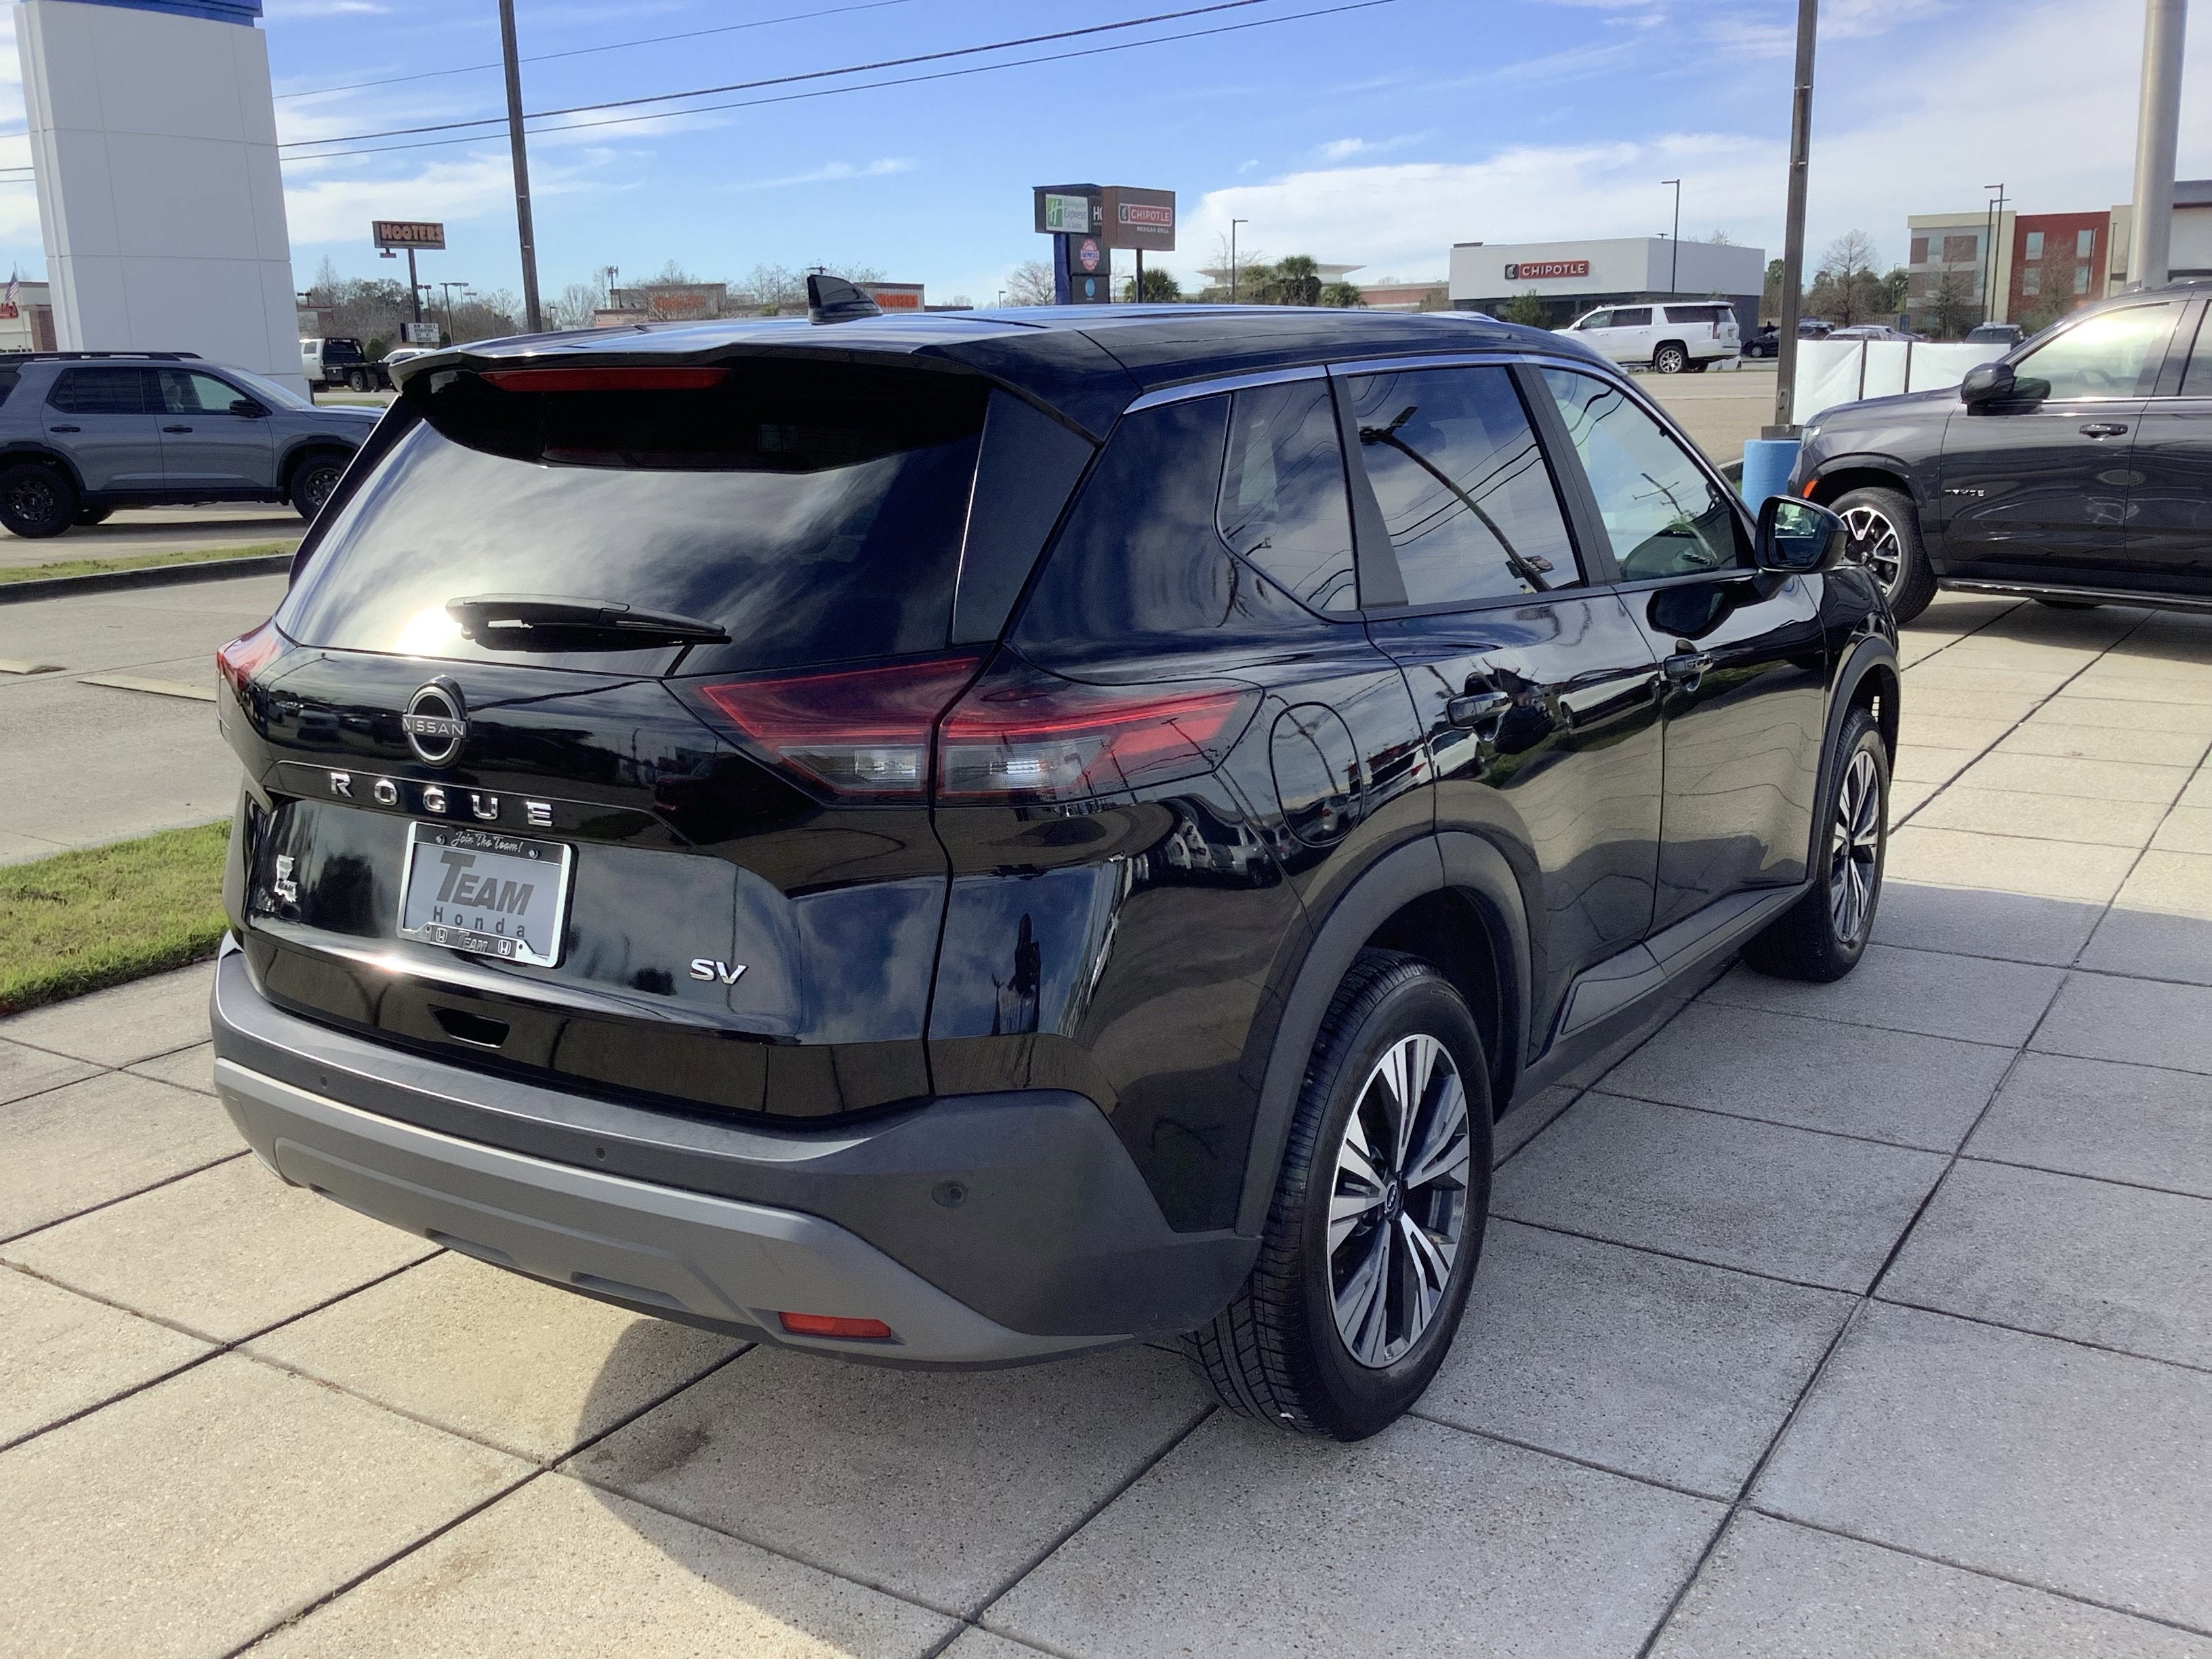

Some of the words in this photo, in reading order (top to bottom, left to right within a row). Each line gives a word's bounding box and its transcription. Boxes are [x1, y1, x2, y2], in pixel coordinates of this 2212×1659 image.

[1130, 209, 1170, 222] CHIPOTLE
[380, 224, 443, 241] HOOTERS
[1522, 263, 1585, 276] CHIPOTLE
[403, 718, 464, 736] NISSAN
[331, 772, 553, 827] ROGUE
[451, 830, 474, 847] Join
[474, 833, 493, 848] The
[493, 836, 524, 853] Team!
[436, 851, 535, 916] TEAM
[432, 905, 526, 938] Honda
[457, 930, 489, 952] TEAM
[689, 958, 747, 985] SV
